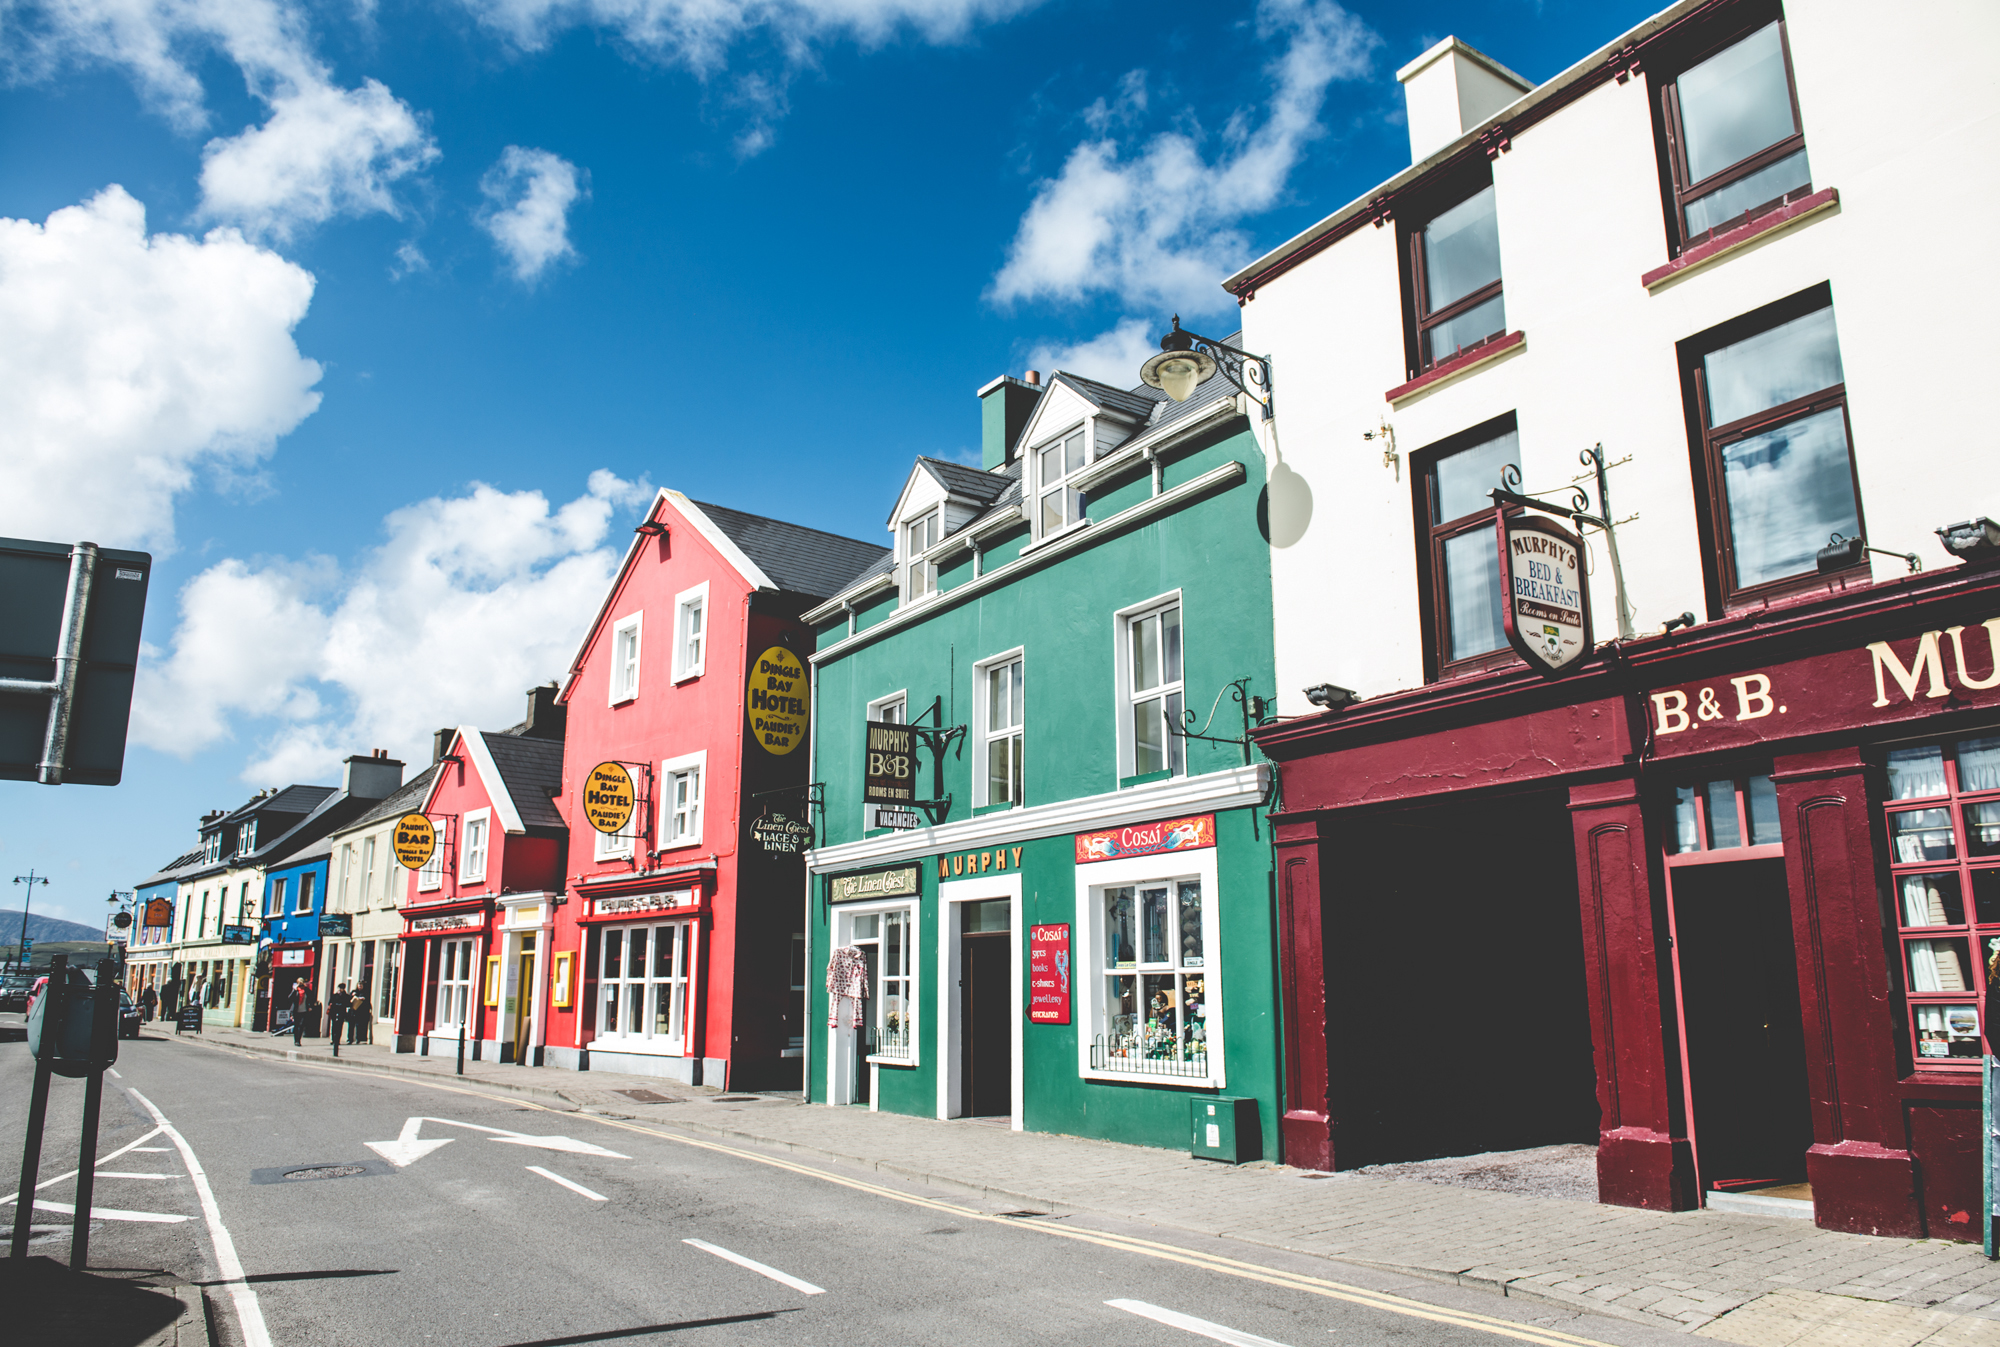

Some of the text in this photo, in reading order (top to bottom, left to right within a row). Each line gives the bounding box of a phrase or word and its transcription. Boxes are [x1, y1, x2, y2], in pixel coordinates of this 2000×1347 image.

[1511, 536, 1577, 570] MURPHY'S
[1528, 560, 1563, 585] BED &
[1515, 576, 1579, 608] BREAKFAST
[1519, 601, 1548, 619] Rooms
[1559, 610, 1580, 626] Suite
[760, 659, 801, 679] DINGLE
[767, 676, 793, 693] BAY
[751, 688, 806, 716] HOTEL
[755, 717, 800, 735] PAUDIE'S
[764, 732, 789, 747] BAR
[869, 727, 909, 753] MURPHYS
[594, 771, 627, 783] DINGLE
[600, 782, 619, 792] BAY
[868, 786, 887, 797] ROOMS
[895, 788, 909, 799] SUITE
[588, 790, 630, 807] HOTEL
[591, 809, 626, 820] PAUDIE'S
[879, 811, 918, 828] VACANCIES
[598, 819, 618, 827] BAR
[756, 819, 784, 832] Linen
[397, 832, 431, 845] BAR
[763, 831, 790, 843] LACE
[764, 841, 797, 852] LINEN
[402, 854, 425, 862] HOTEL
[938, 846, 1023, 878] MURPHY
[843, 870, 906, 897] The Linen Chest
[1032, 963, 1048, 972] books
[1032, 994, 1062, 1005] jewellery
